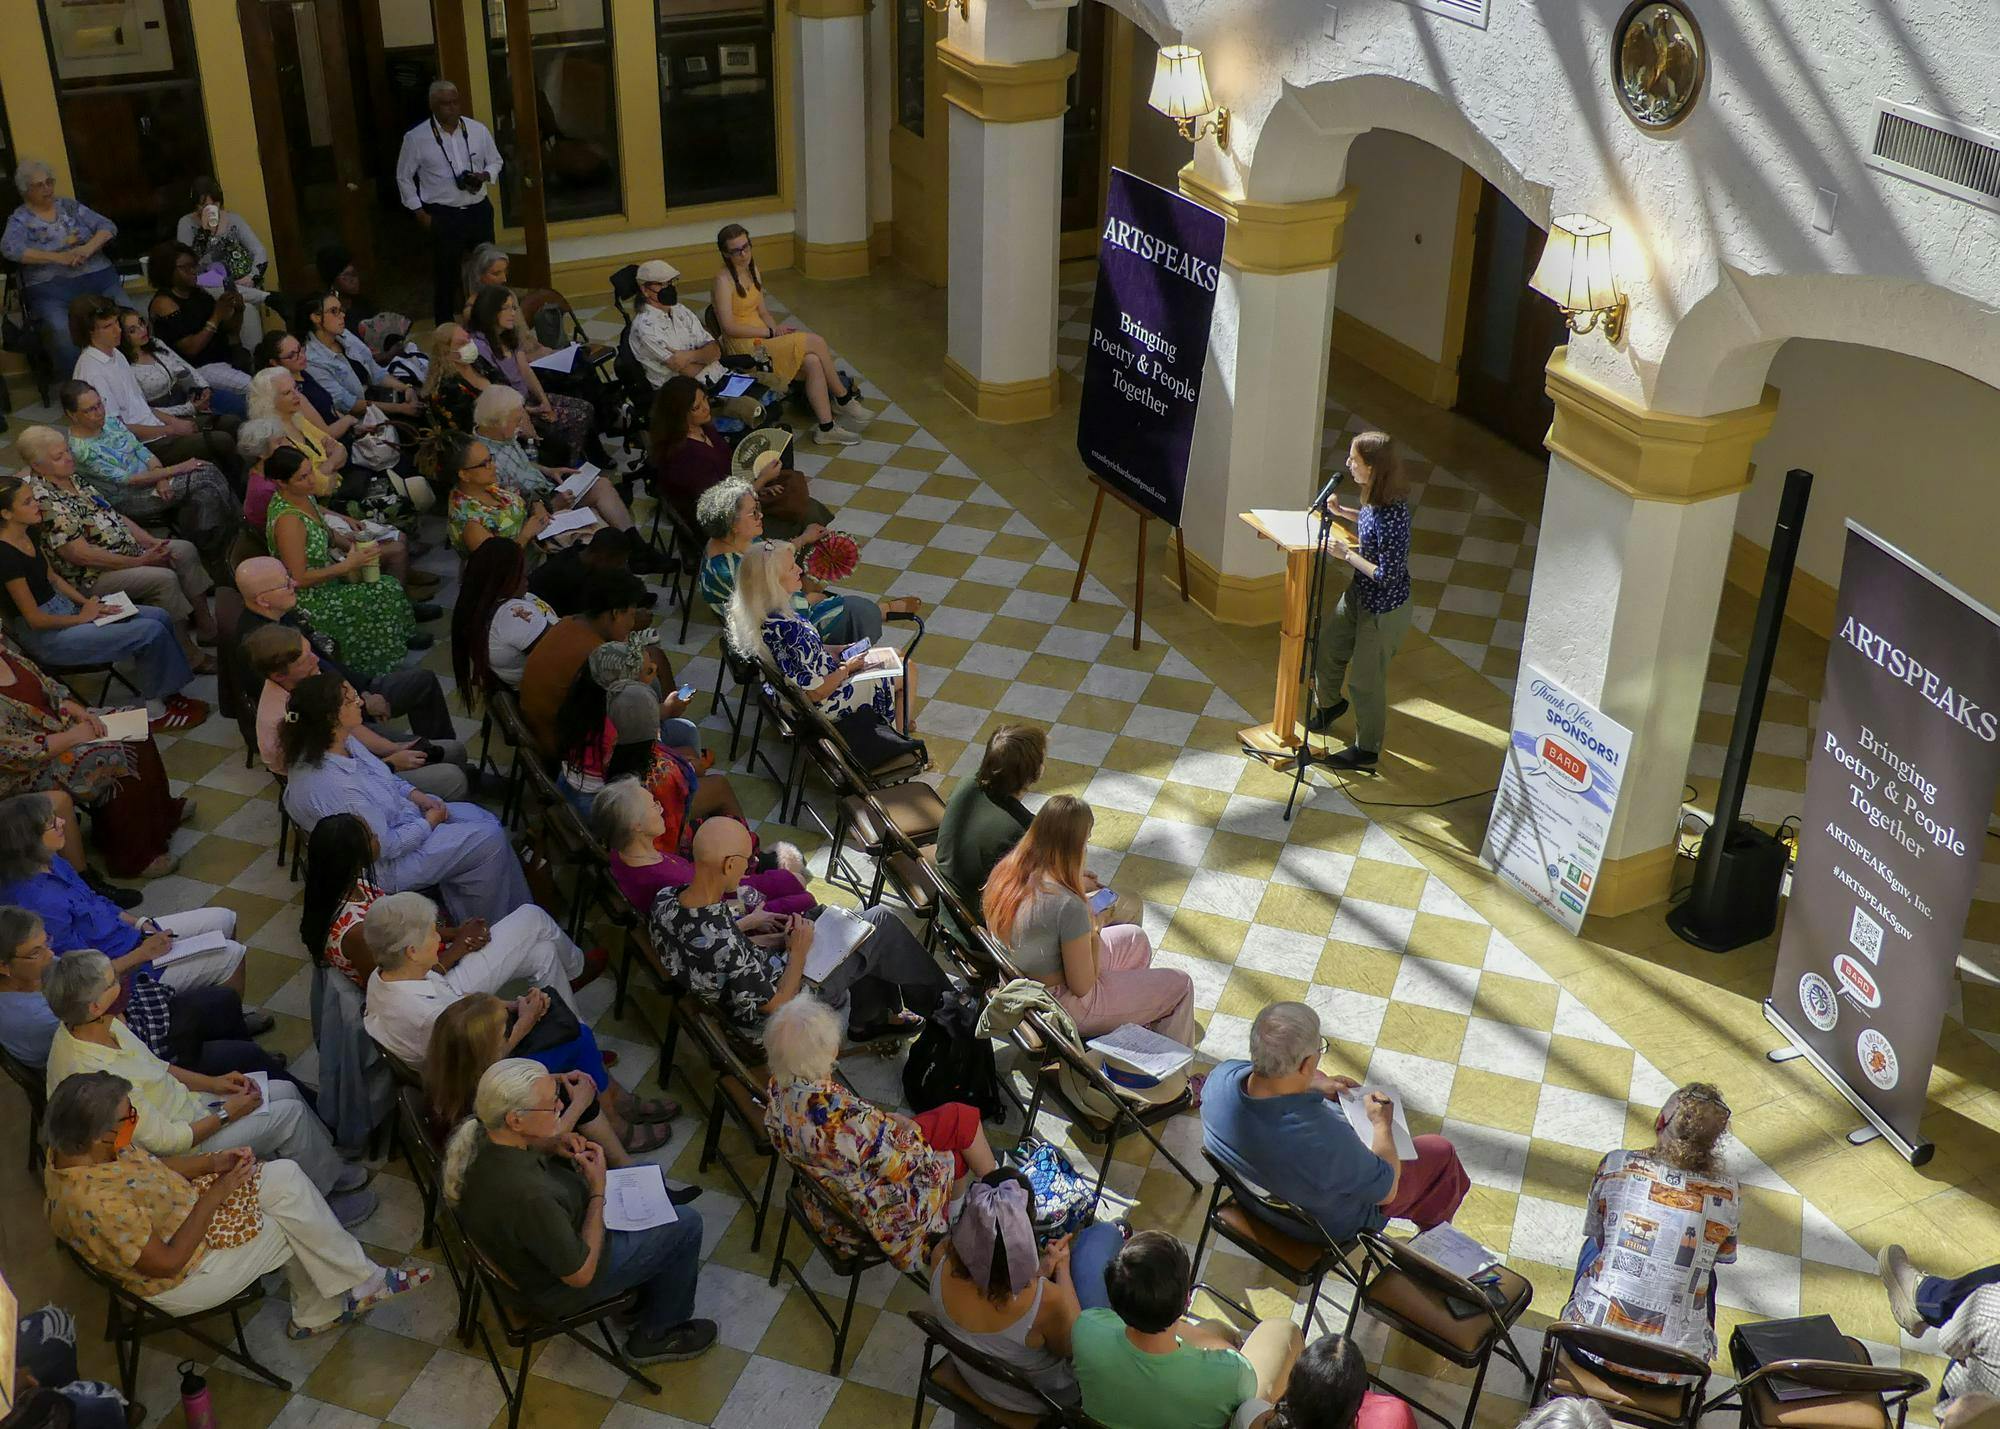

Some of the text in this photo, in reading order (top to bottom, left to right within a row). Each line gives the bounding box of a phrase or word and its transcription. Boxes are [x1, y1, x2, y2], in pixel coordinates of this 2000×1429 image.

[1103, 216, 1218, 292] ARTSPEAKS
[1092, 328, 1196, 402] Poetry & People
[1120, 311, 1177, 363] Bringing
[1113, 368, 1169, 416] Together
[1530, 680, 1565, 711] Thank
[1840, 615, 1998, 742] ARTSPEAKS
[1546, 708, 1619, 767] SPONSORS!
[1549, 746, 1580, 774] BARD
[1858, 725, 1937, 805] Bringing
[1824, 731, 1965, 857] Poetry & People
[1850, 783, 1925, 859] Together
[1825, 822, 1933, 920] ARTSPEAKSgnv, Inc.
[1833, 865, 1913, 940] #ARTSPEAKSgnv
[1845, 964, 1870, 993] BARD
